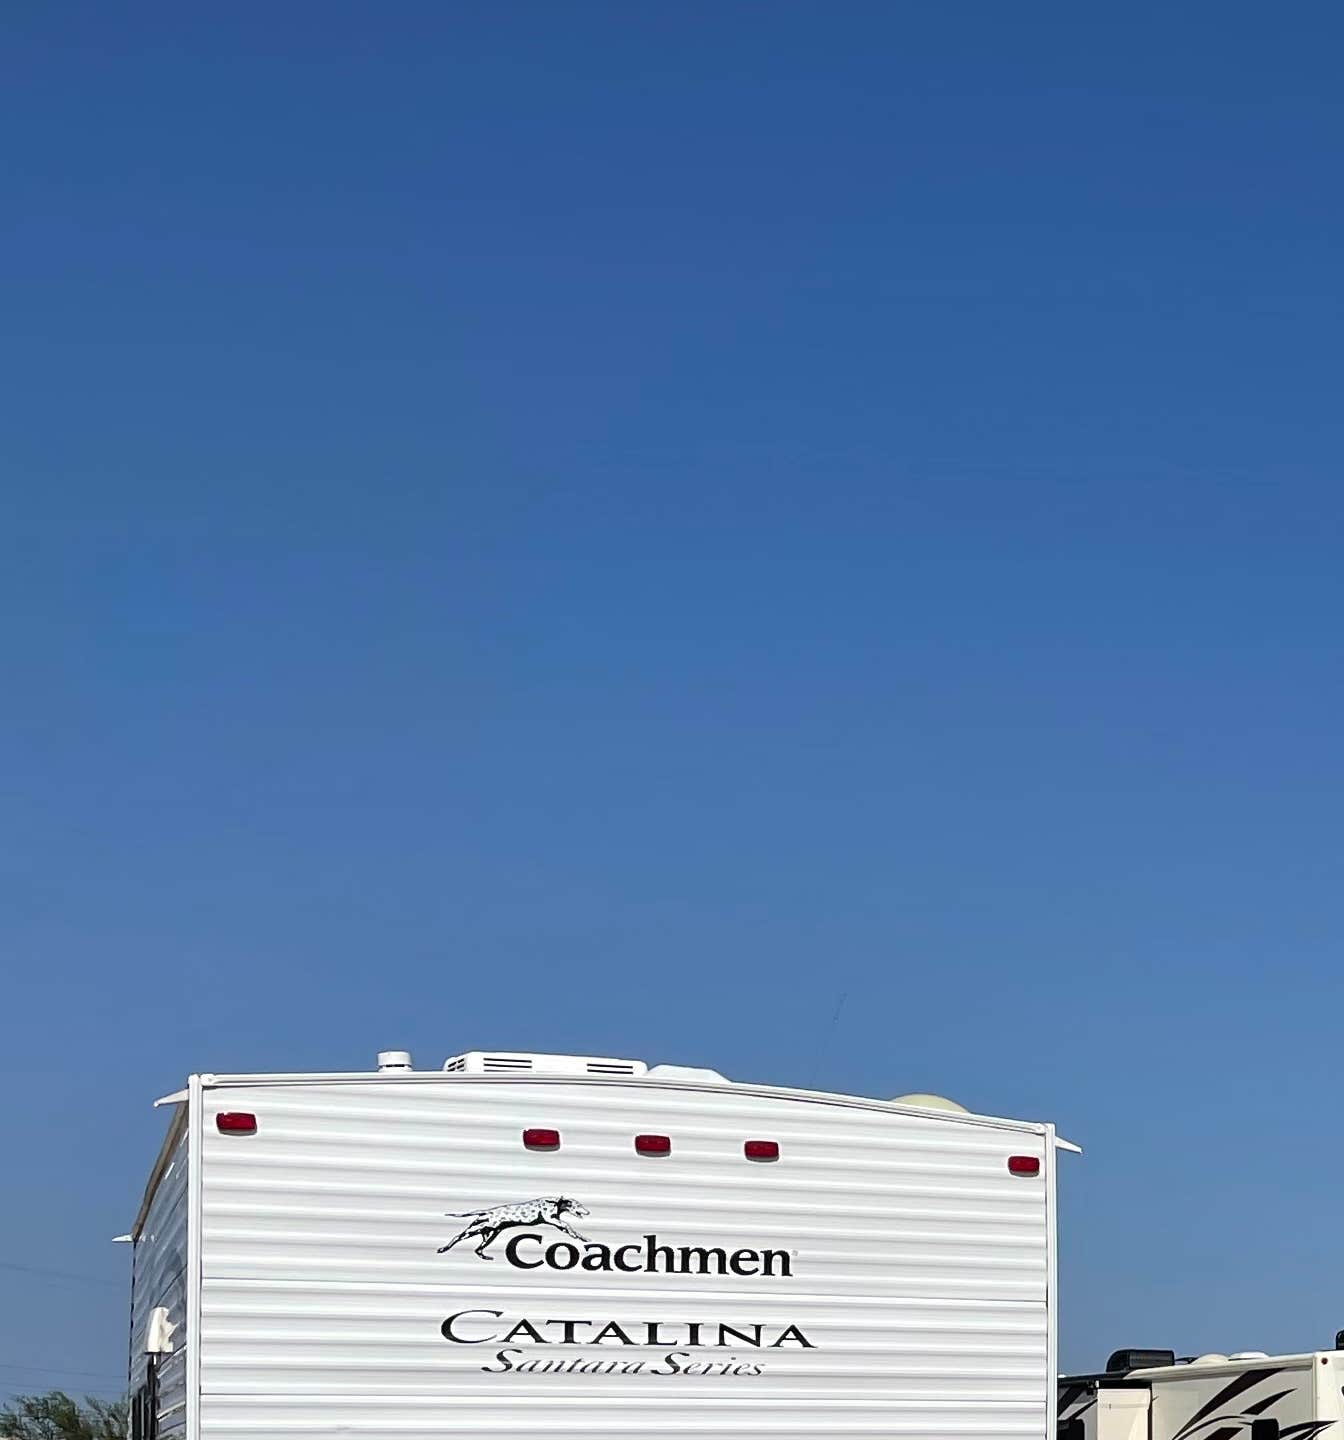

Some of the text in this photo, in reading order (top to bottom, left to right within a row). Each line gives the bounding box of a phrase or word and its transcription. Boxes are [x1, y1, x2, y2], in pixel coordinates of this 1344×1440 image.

[505, 1233, 794, 1277] Coachmen
[440, 1309, 818, 1349] CATALINA
[481, 1348, 767, 1377] Santara Series
